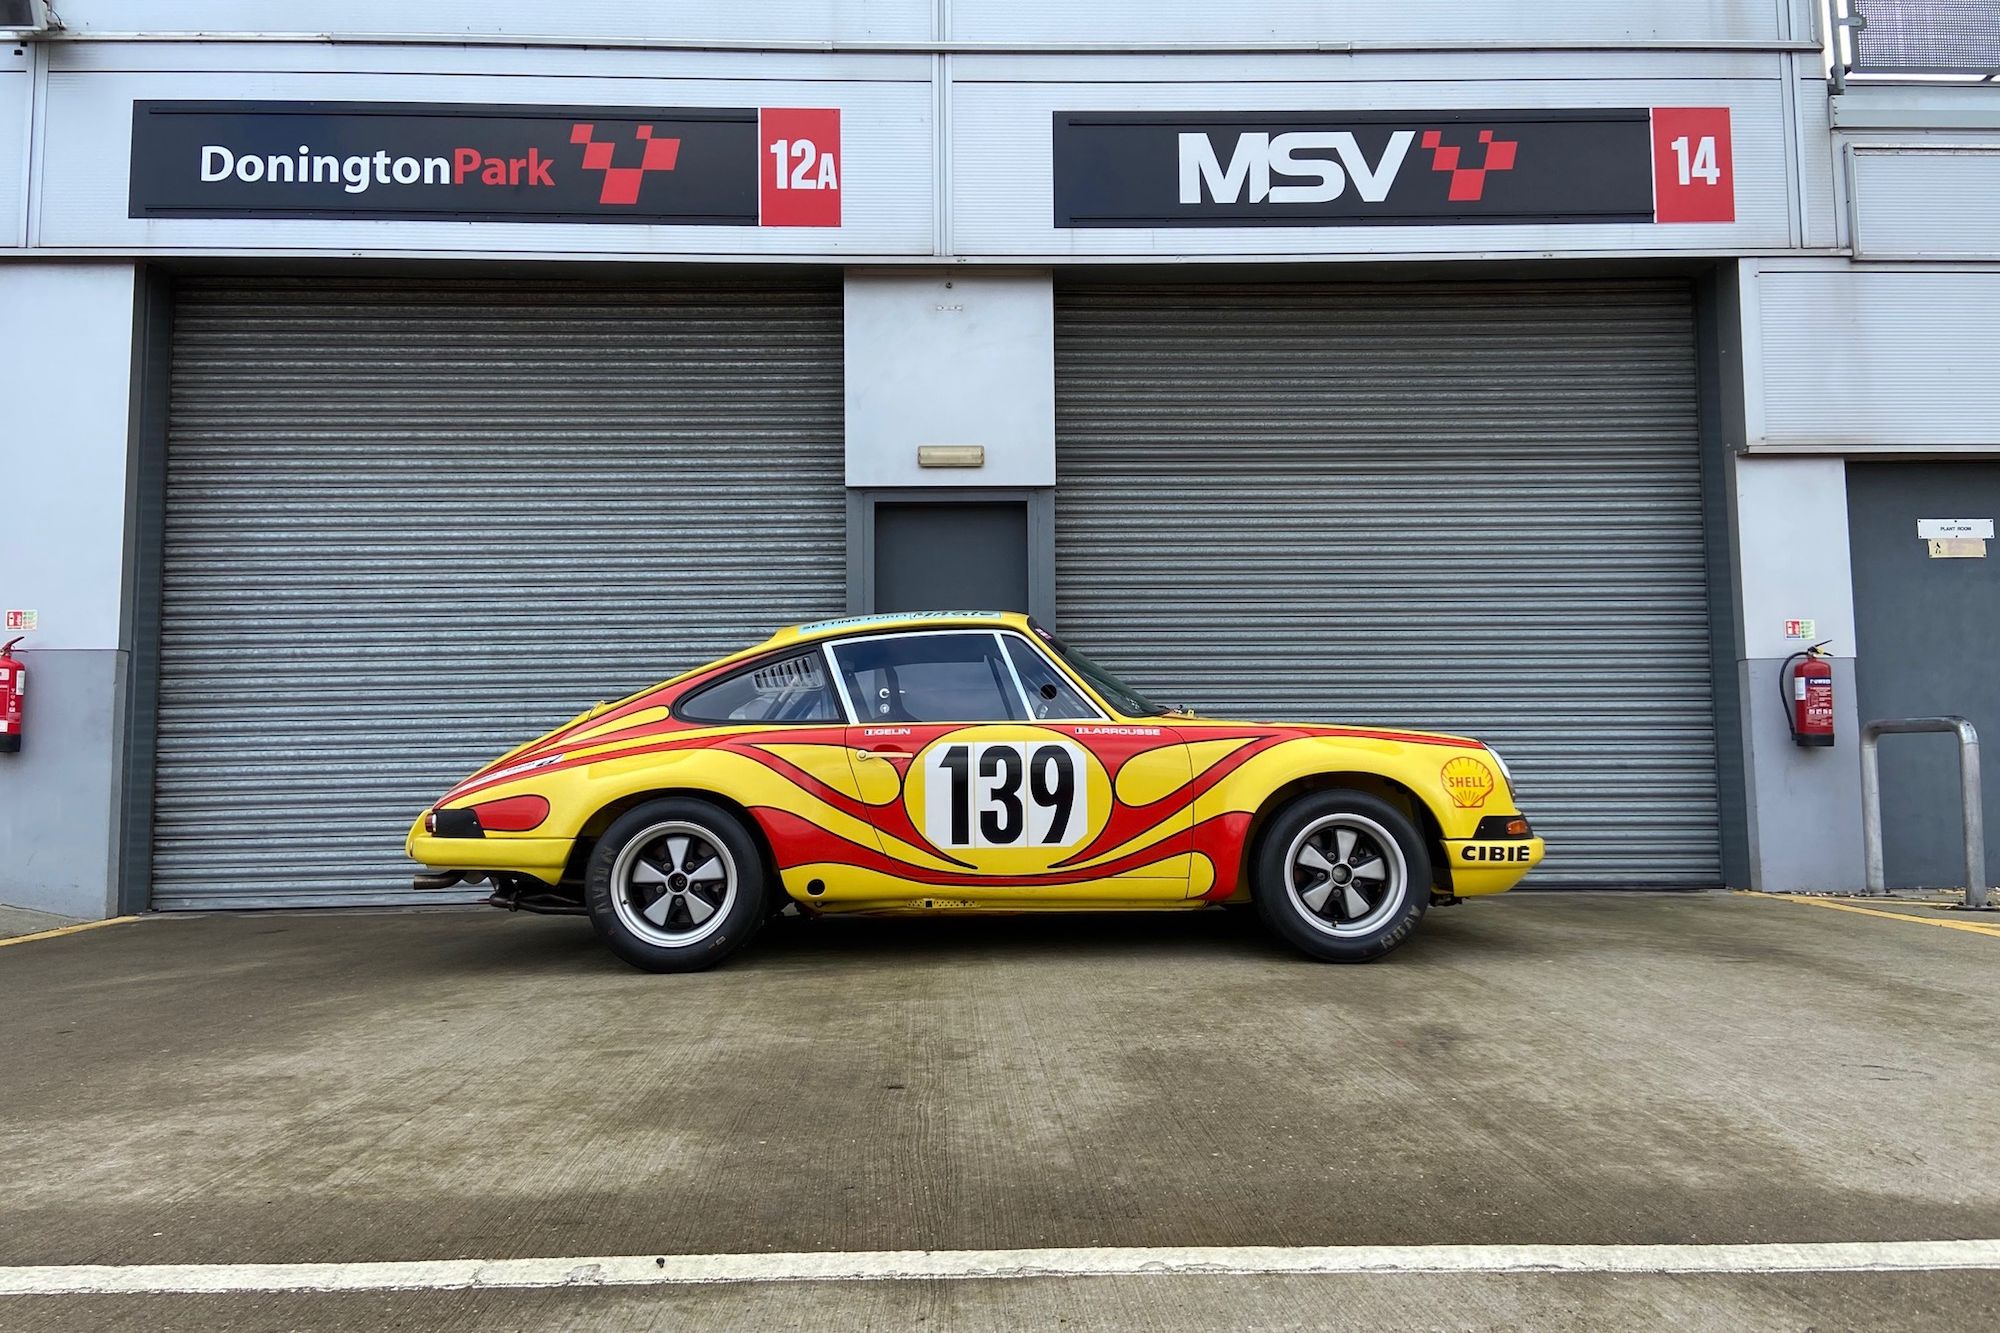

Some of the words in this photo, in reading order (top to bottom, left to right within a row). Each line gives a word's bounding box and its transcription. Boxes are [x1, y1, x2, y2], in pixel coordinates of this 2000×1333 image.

[769, 138, 838, 189] 12A
[1178, 131, 1417, 204] MSV
[1671, 136, 1721, 185] 14
[802, 618, 861, 630] SETTING
[874, 728, 911, 736] GELIN
[1084, 727, 1161, 736] LARROUSSE
[1449, 776, 1486, 788] SHELL
[938, 744, 1075, 845] 139
[1461, 845, 1530, 862] CIBIE
